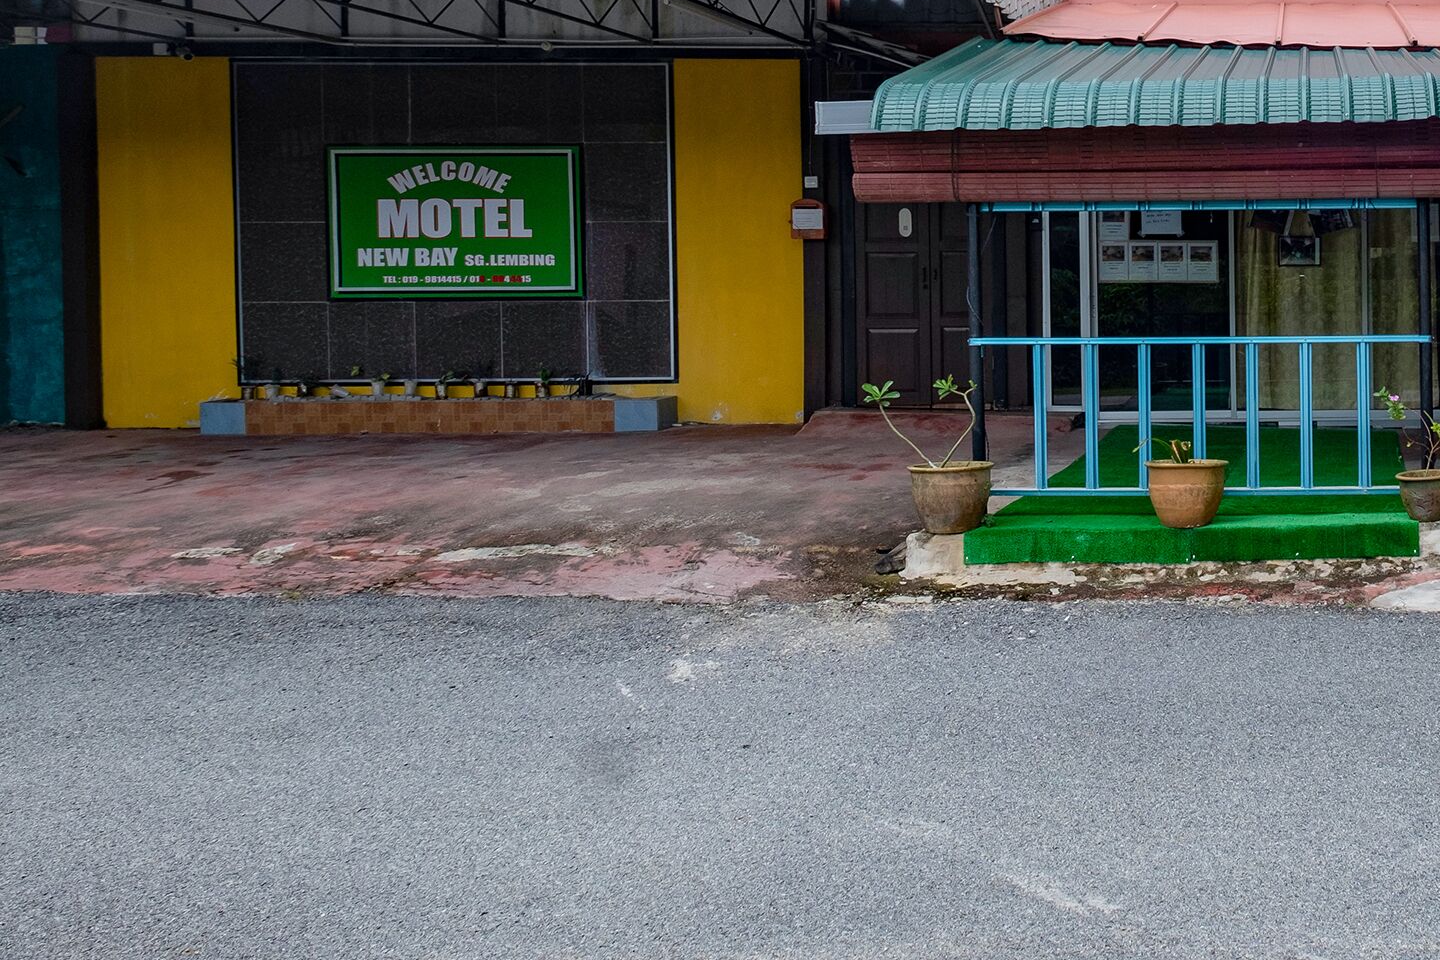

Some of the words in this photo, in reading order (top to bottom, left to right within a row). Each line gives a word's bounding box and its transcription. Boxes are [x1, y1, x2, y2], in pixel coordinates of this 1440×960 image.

[387, 160, 512, 194] WELCOME
[377, 197, 533, 239] MOTEL
[357, 247, 410, 267] NEW
[414, 247, 459, 267] BAY
[464, 253, 556, 267] SG.LEMBING
[383, 275, 397, 283] TEL
[402, 275, 418, 283] 019
[424, 275, 462, 283] 9814415
